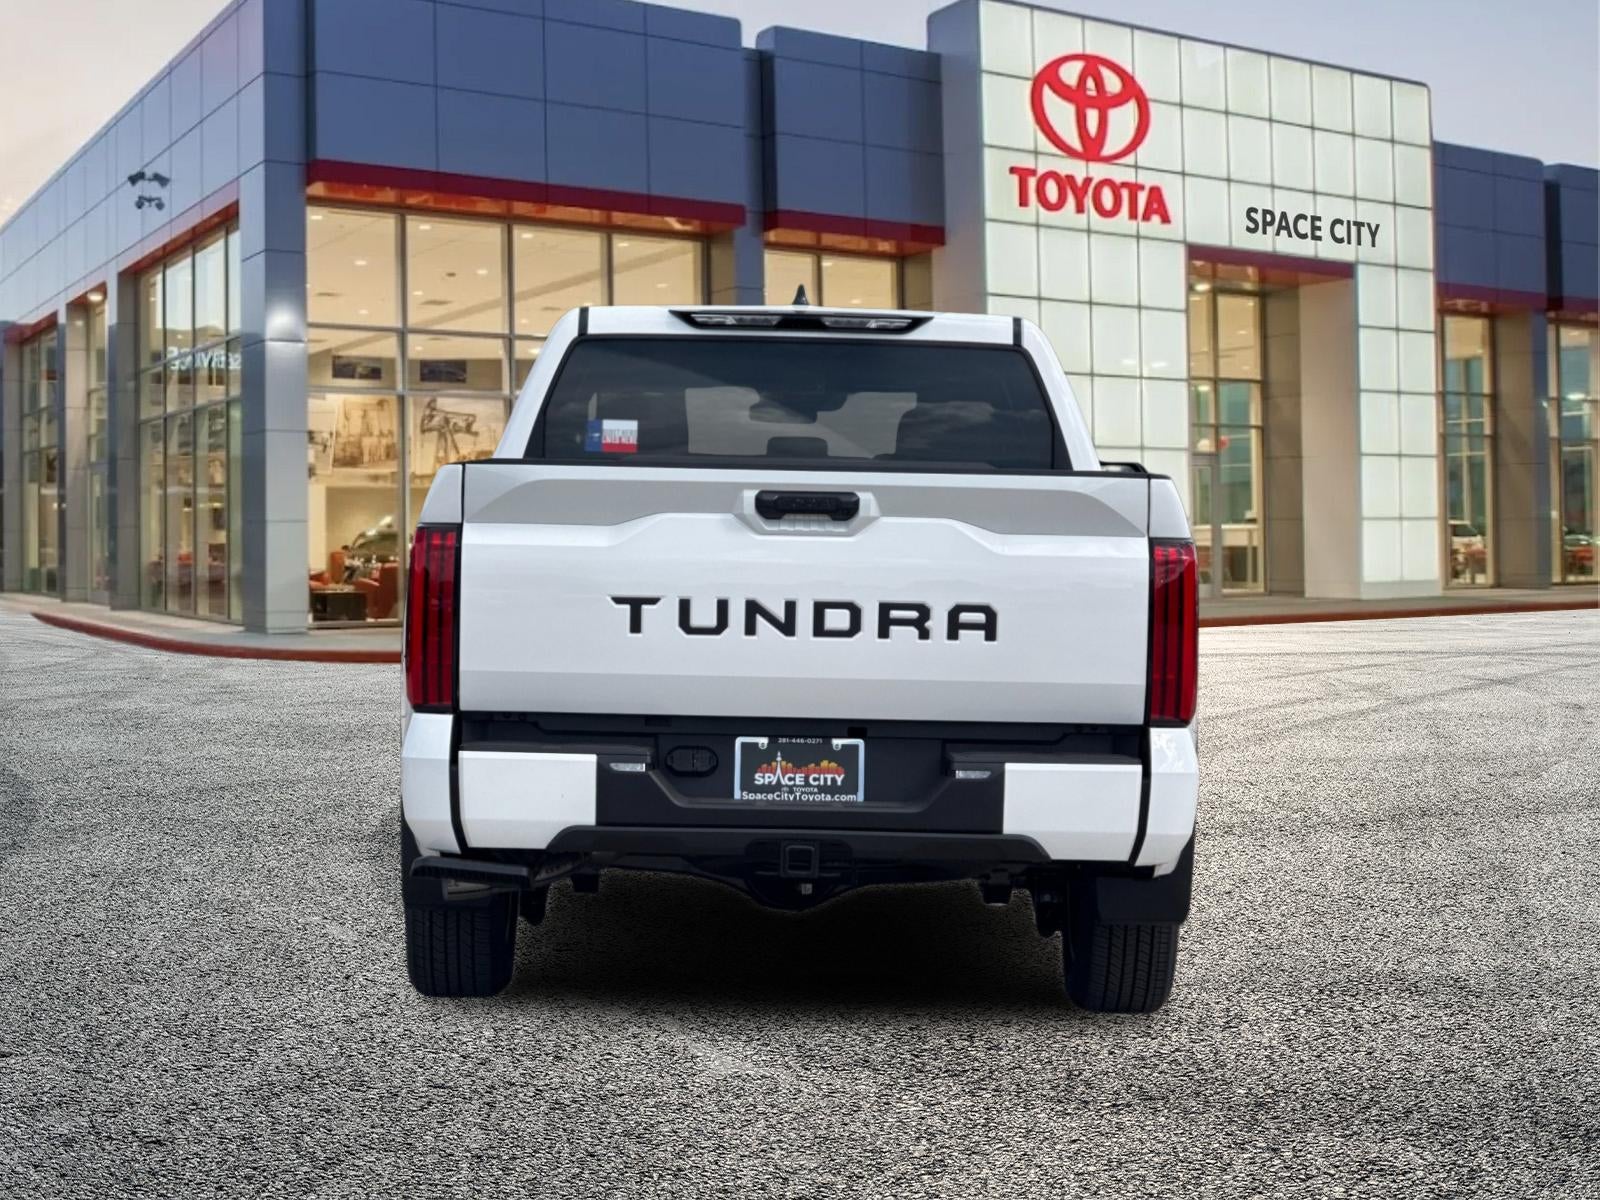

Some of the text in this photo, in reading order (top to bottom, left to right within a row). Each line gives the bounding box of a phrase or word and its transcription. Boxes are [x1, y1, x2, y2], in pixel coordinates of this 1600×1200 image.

[1009, 166, 1171, 224] TOYOTA
[1245, 206, 1381, 248] SPACE CITY
[610, 595, 998, 642] TUNDRA
[742, 791, 857, 802] SpaceCityToyota.com
[754, 772, 845, 786] SPACE CITY
